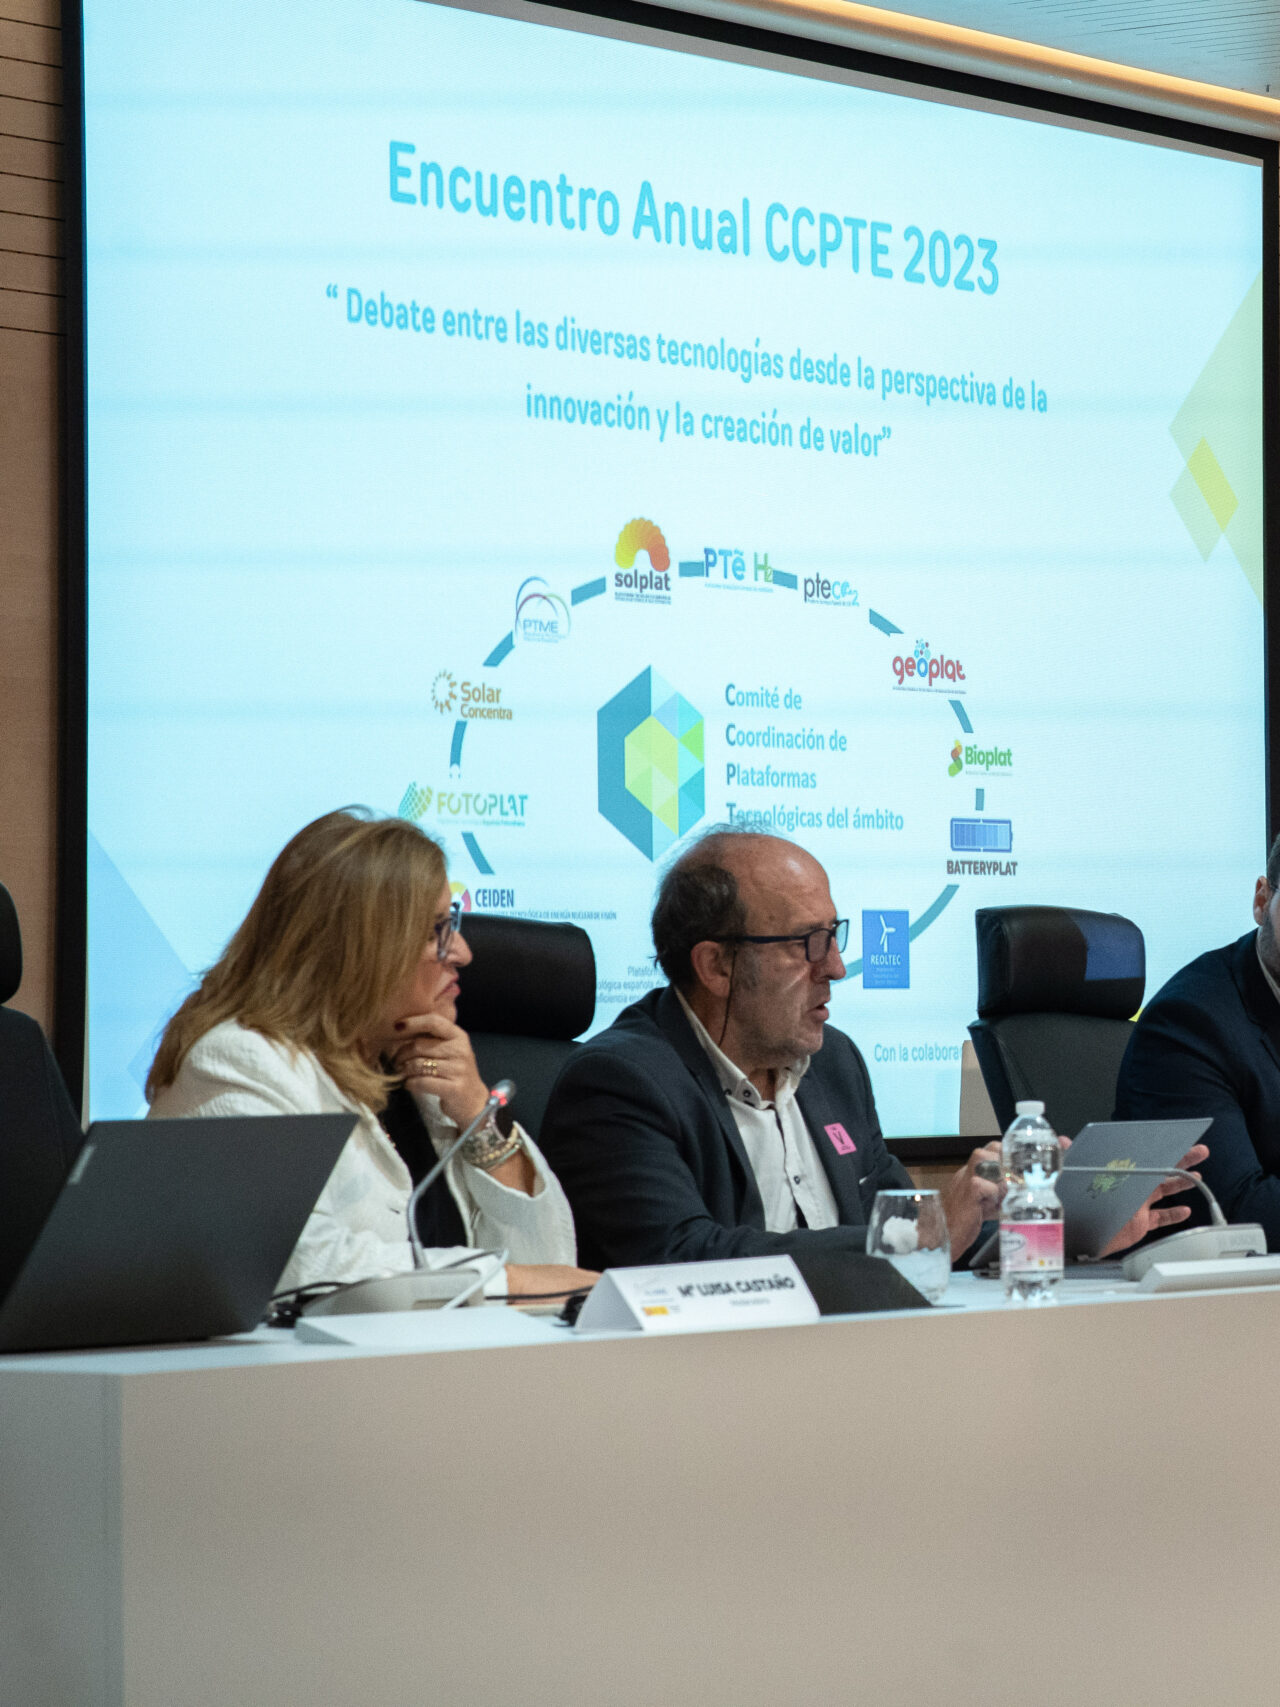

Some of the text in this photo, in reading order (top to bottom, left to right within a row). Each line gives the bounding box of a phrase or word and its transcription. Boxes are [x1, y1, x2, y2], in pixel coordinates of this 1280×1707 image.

[388, 140, 999, 295] Encuentro Anual CCPTE 2023
[347, 287, 436, 334] Debate
[442, 308, 508, 343] entre
[515, 309, 549, 349] las
[555, 316, 651, 362] diversas
[656, 333, 784, 383] tecnologías
[789, 347, 851, 387] desde
[857, 356, 875, 390] la
[881, 366, 997, 406] perspectiva
[1002, 377, 1026, 410] de
[1031, 379, 1048, 413] la
[526, 382, 650, 431] innovación
[657, 408, 669, 443] y
[675, 400, 695, 436] la
[701, 408, 793, 447] creación
[799, 416, 825, 452] de
[614, 569, 671, 593] solplat
[523, 619, 559, 634] PTME
[892, 653, 966, 687] geoplat
[460, 681, 502, 704] Solar
[725, 683, 802, 711] Comité de
[460, 703, 513, 721] Concentra
[725, 723, 847, 752] Coordinación de
[965, 744, 1013, 771] Bioplat
[726, 762, 817, 789] Plataformas
[437, 792, 528, 817] FOTOPLAT
[726, 803, 904, 832] Tecnológicas del ámbito
[946, 859, 1018, 877] BATTERYPLAT
[475, 889, 514, 908] CEIDEN
[871, 954, 901, 966] REOLTEC
[874, 1042, 961, 1062] Con la colabora
[699, 1280, 736, 1297] LUISA
[736, 1274, 795, 1294] CASTAÑO
